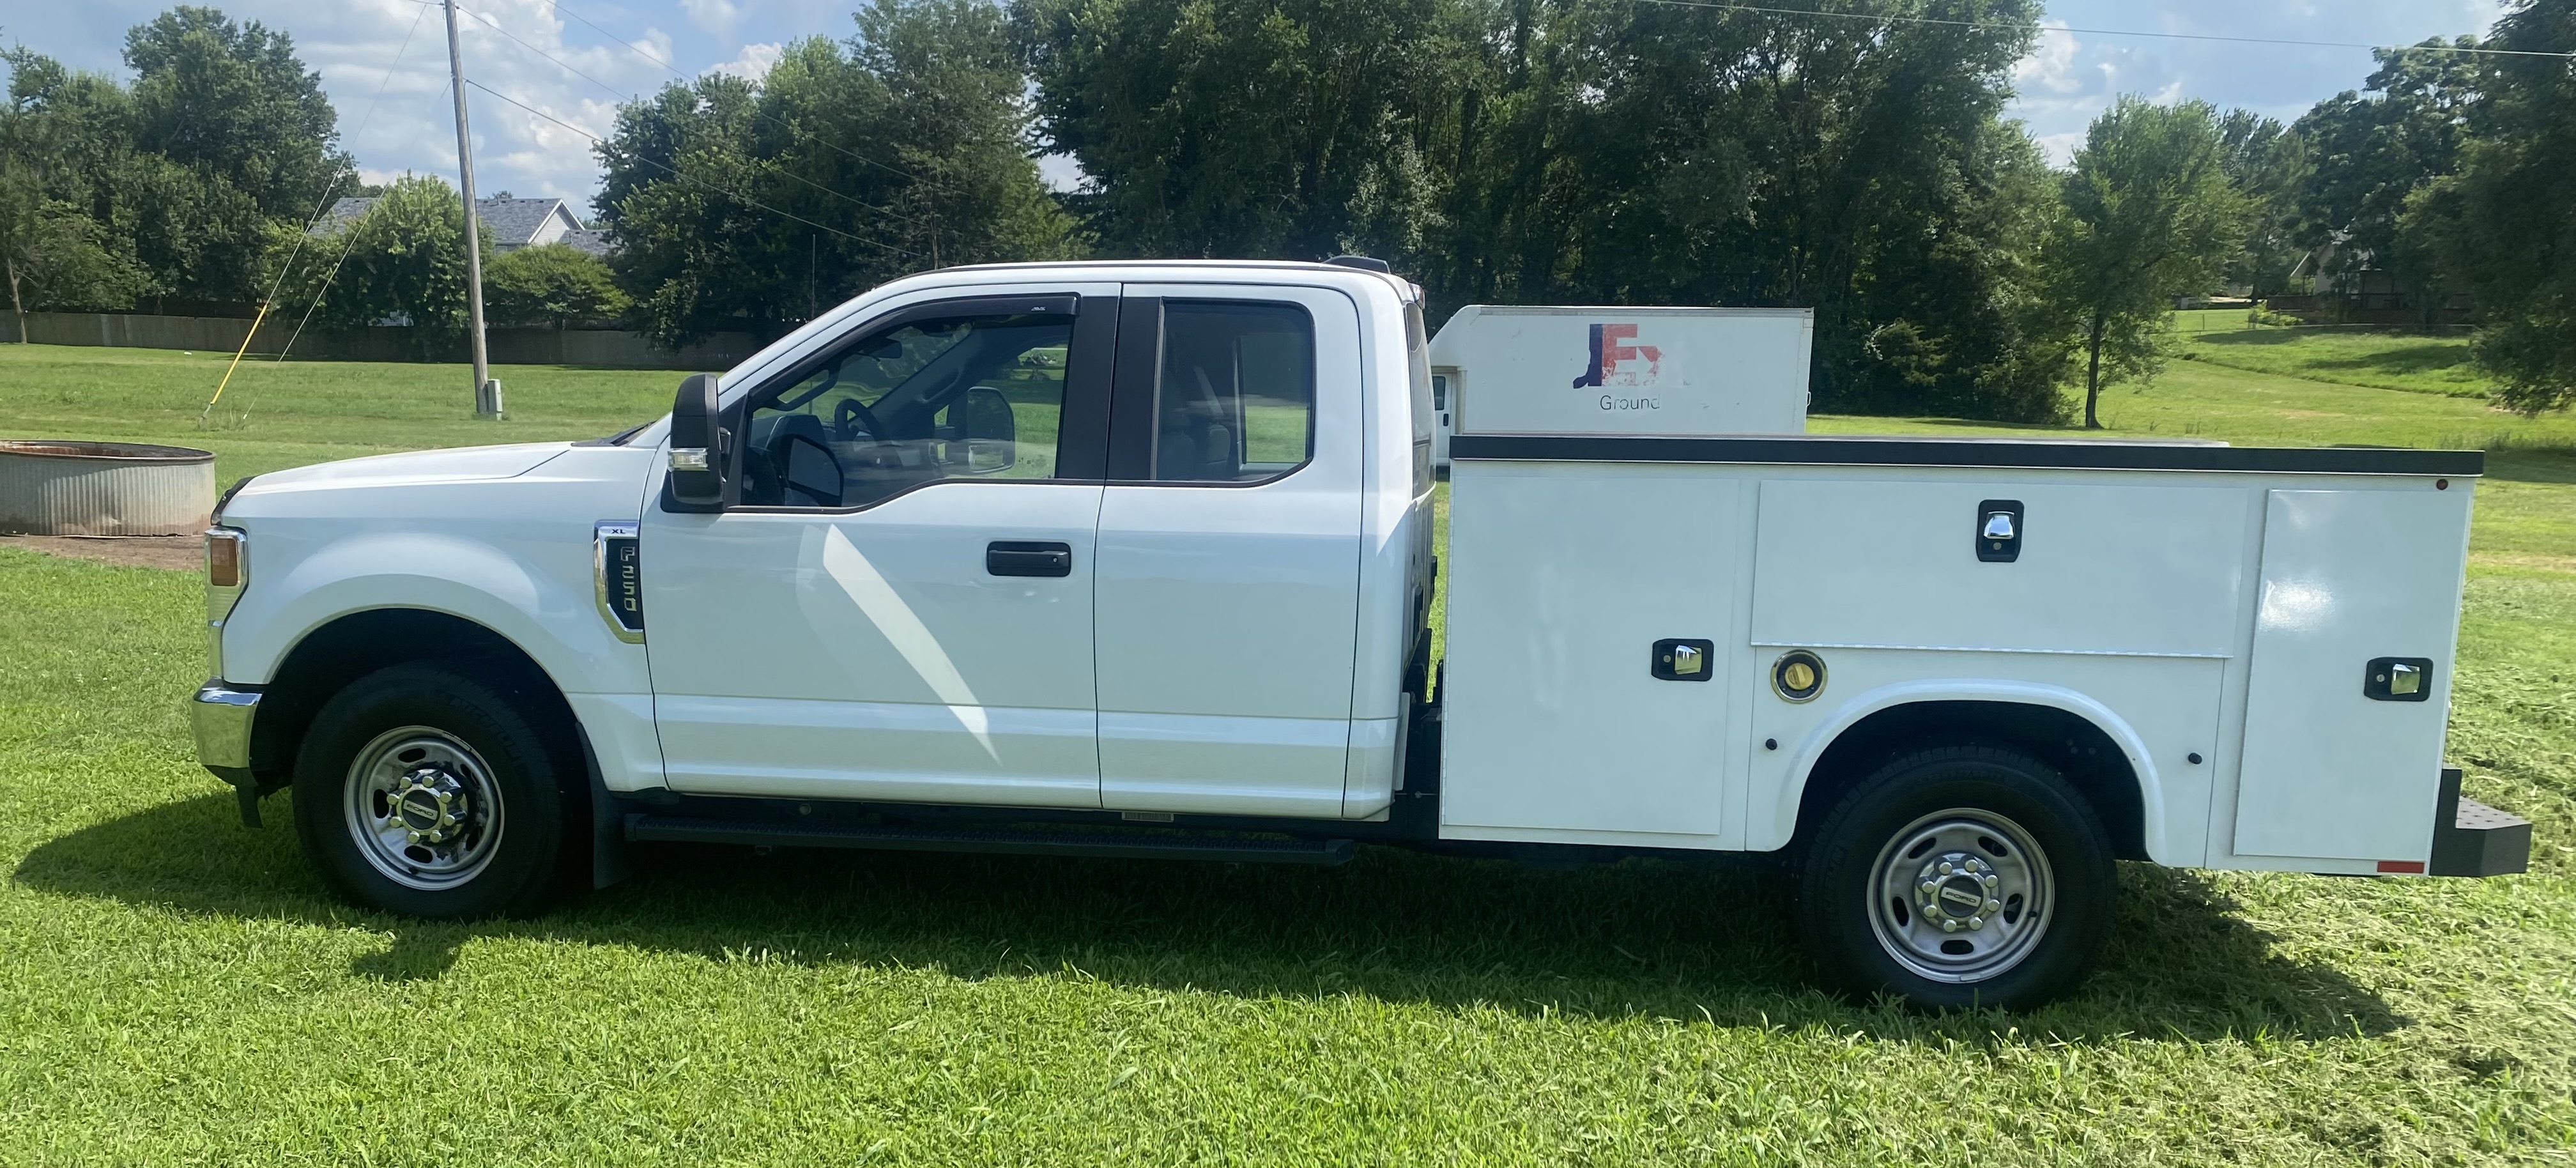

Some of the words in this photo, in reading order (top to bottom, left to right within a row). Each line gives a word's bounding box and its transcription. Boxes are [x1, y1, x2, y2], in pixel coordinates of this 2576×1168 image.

[1600, 394, 1661, 410] Ground
[620, 546, 638, 612] F250
[406, 803, 434, 818] FORD
[1945, 891, 1977, 904] FORD
